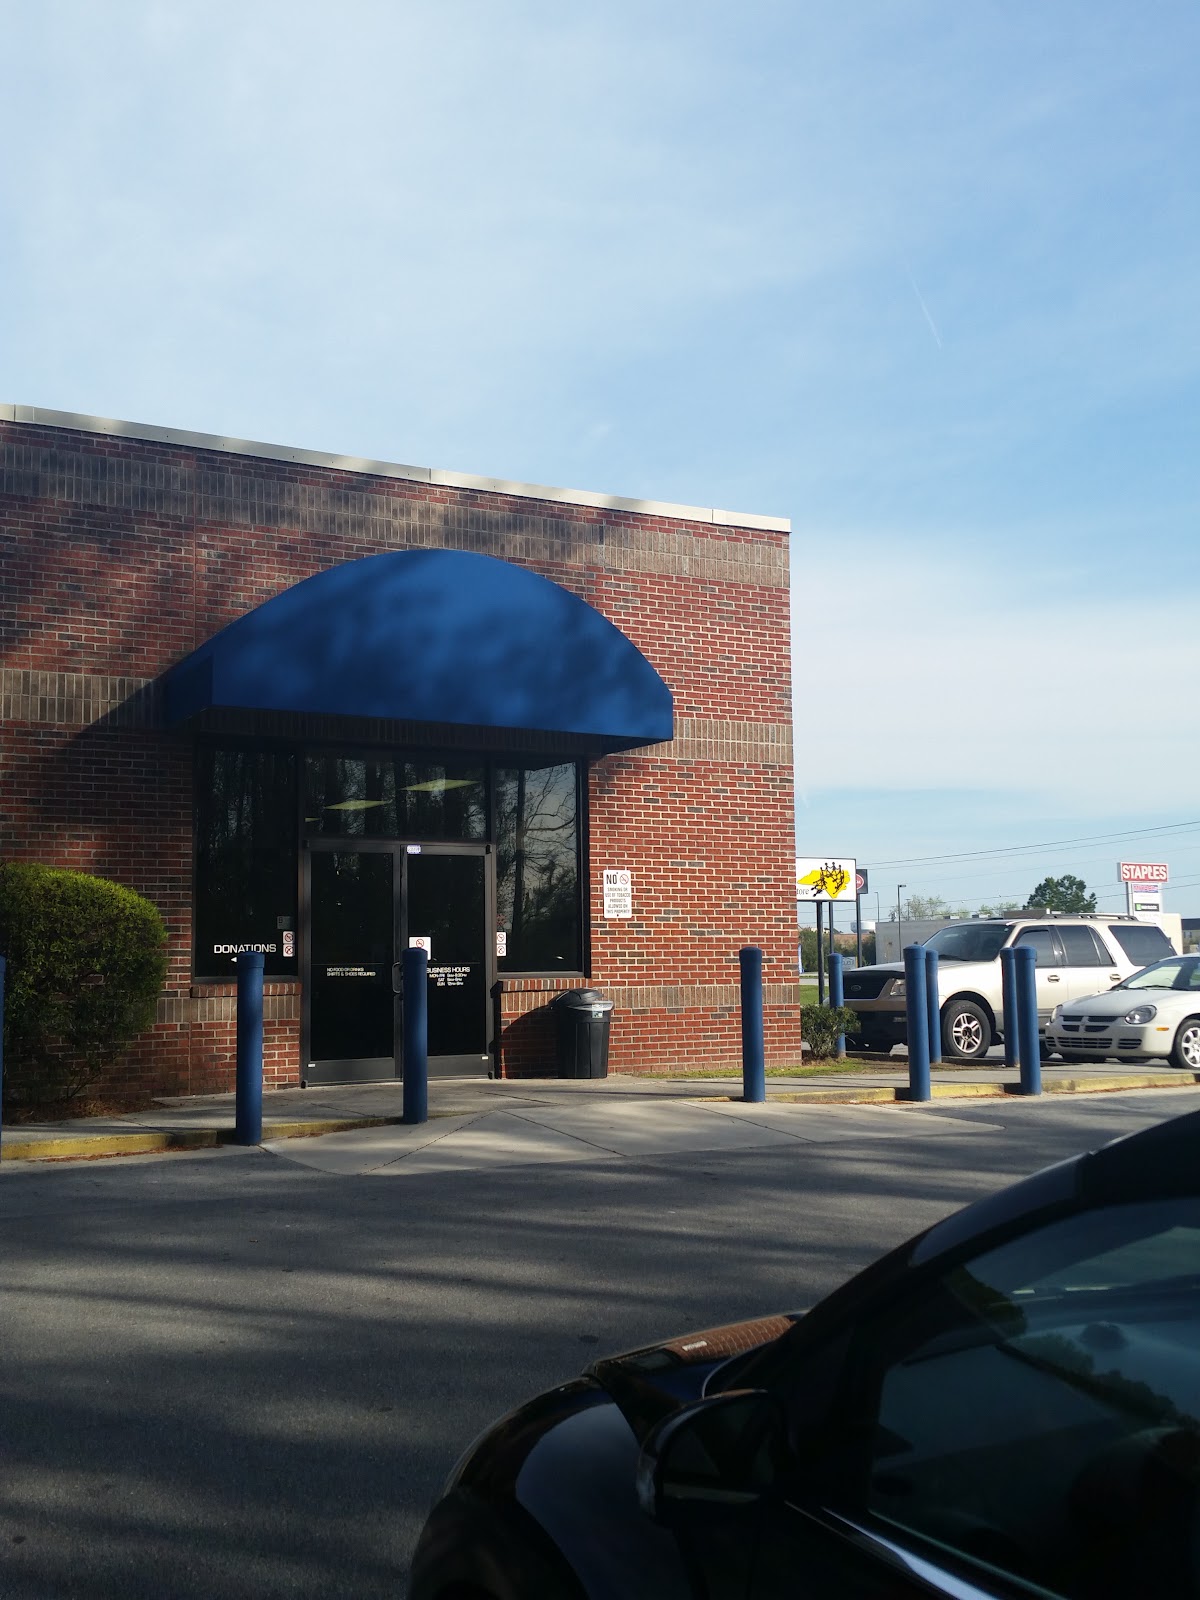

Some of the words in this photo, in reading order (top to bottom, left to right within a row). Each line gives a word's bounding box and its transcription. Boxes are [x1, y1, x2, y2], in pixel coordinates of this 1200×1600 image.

[1122, 864, 1167, 880] STAPLES
[606, 874, 617, 885] NO
[213, 944, 277, 954] DONATIONS
